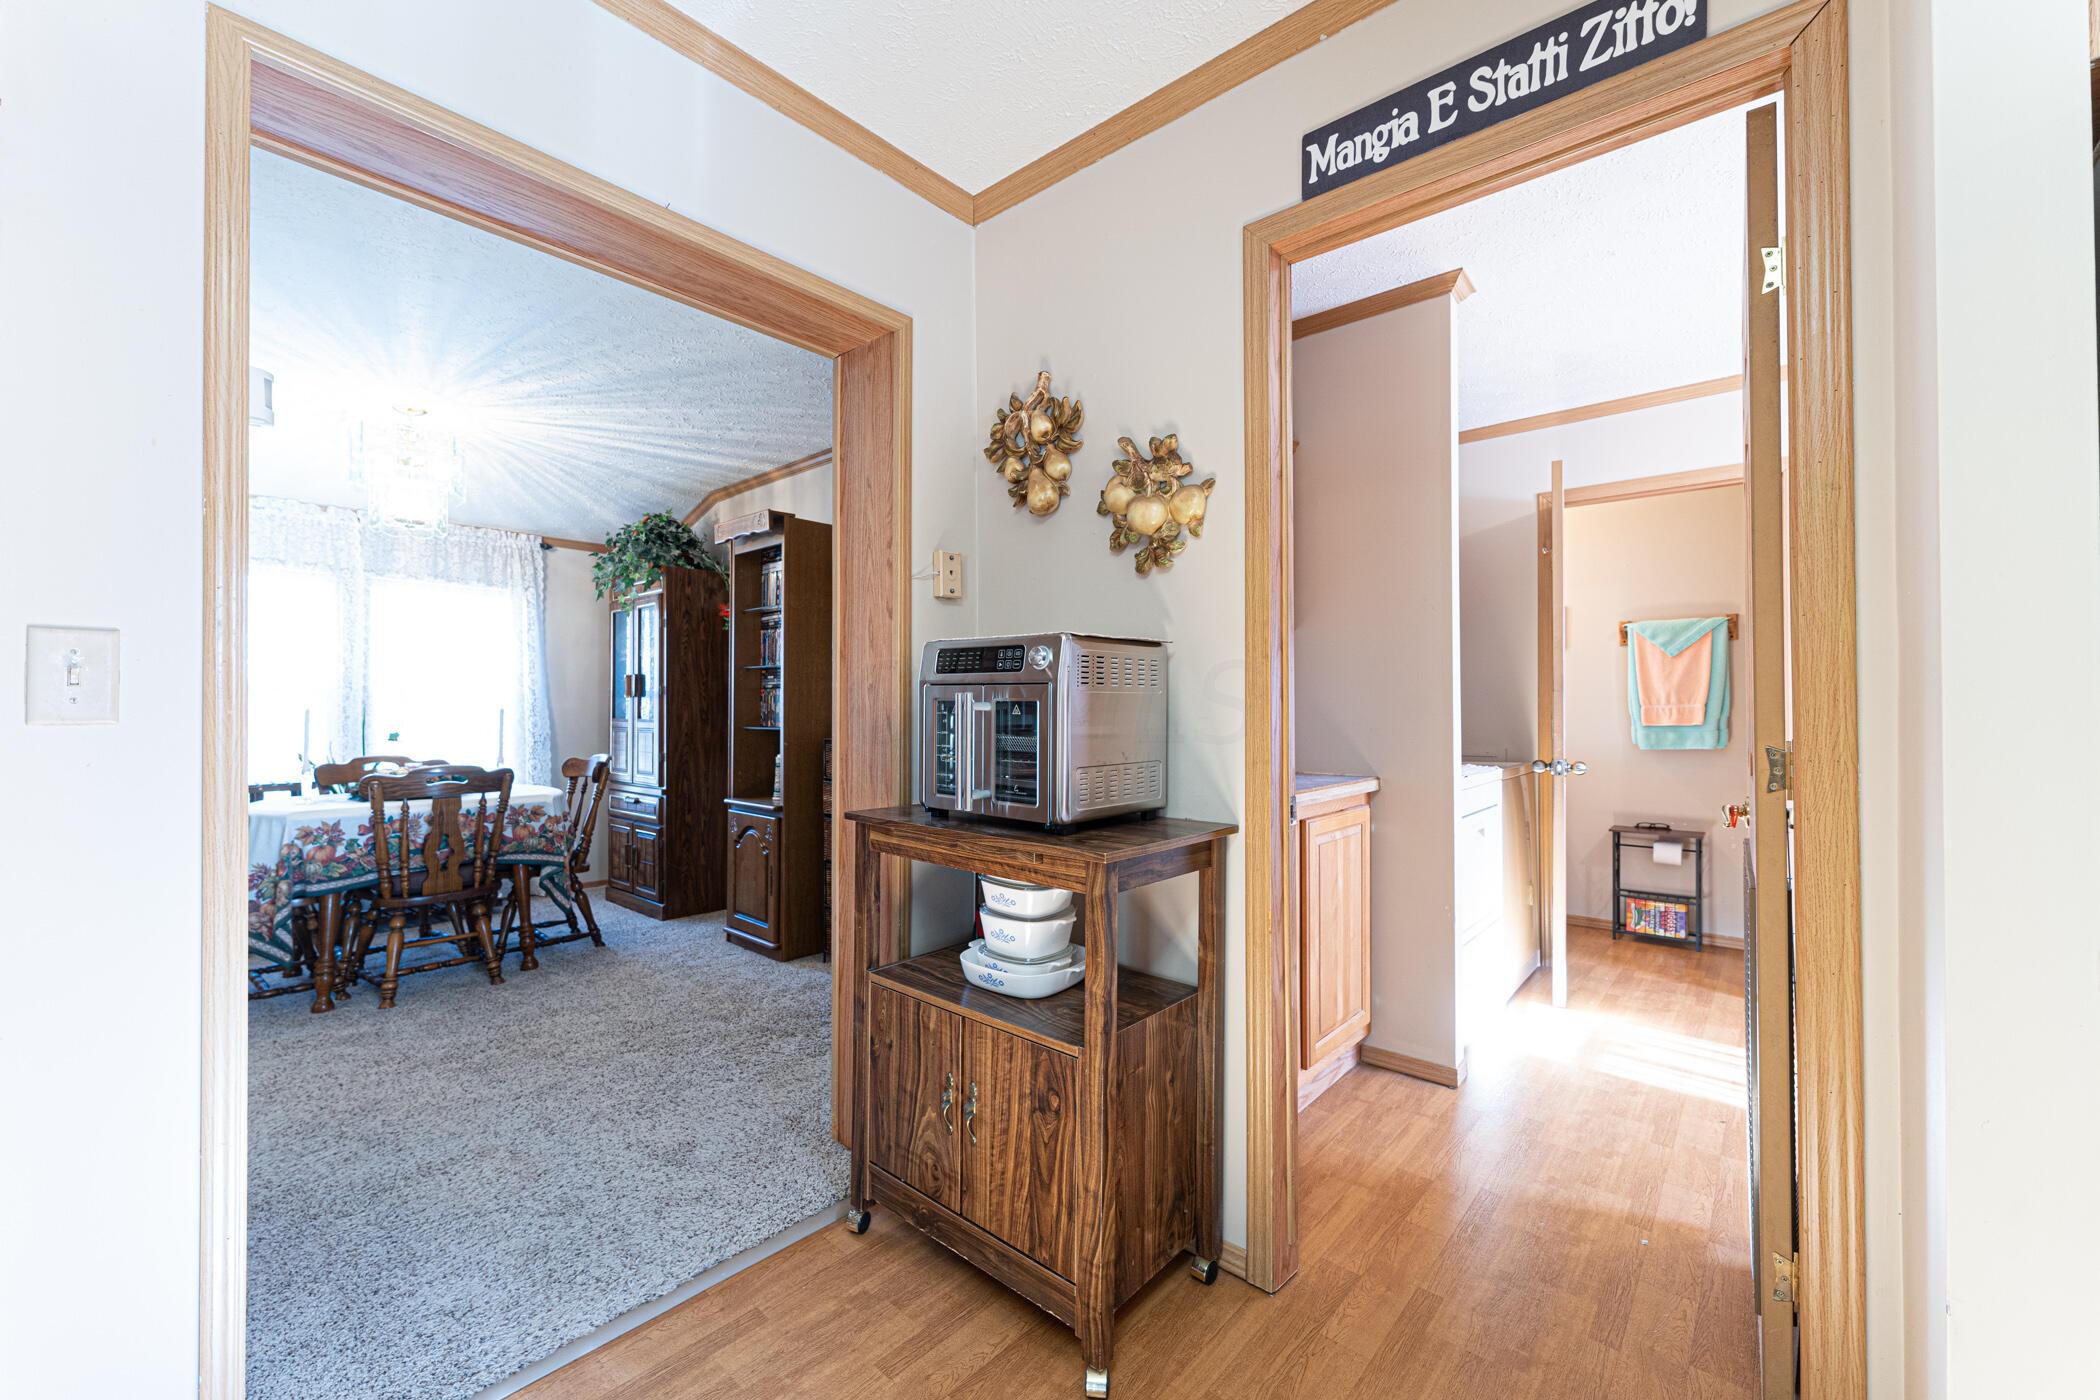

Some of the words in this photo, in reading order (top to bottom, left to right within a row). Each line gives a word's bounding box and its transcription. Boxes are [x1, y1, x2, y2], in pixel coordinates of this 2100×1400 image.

[1305, 108, 1420, 185] Mangia
[1426, 80, 1459, 134] E
[1467, 32, 1569, 112] Statti
